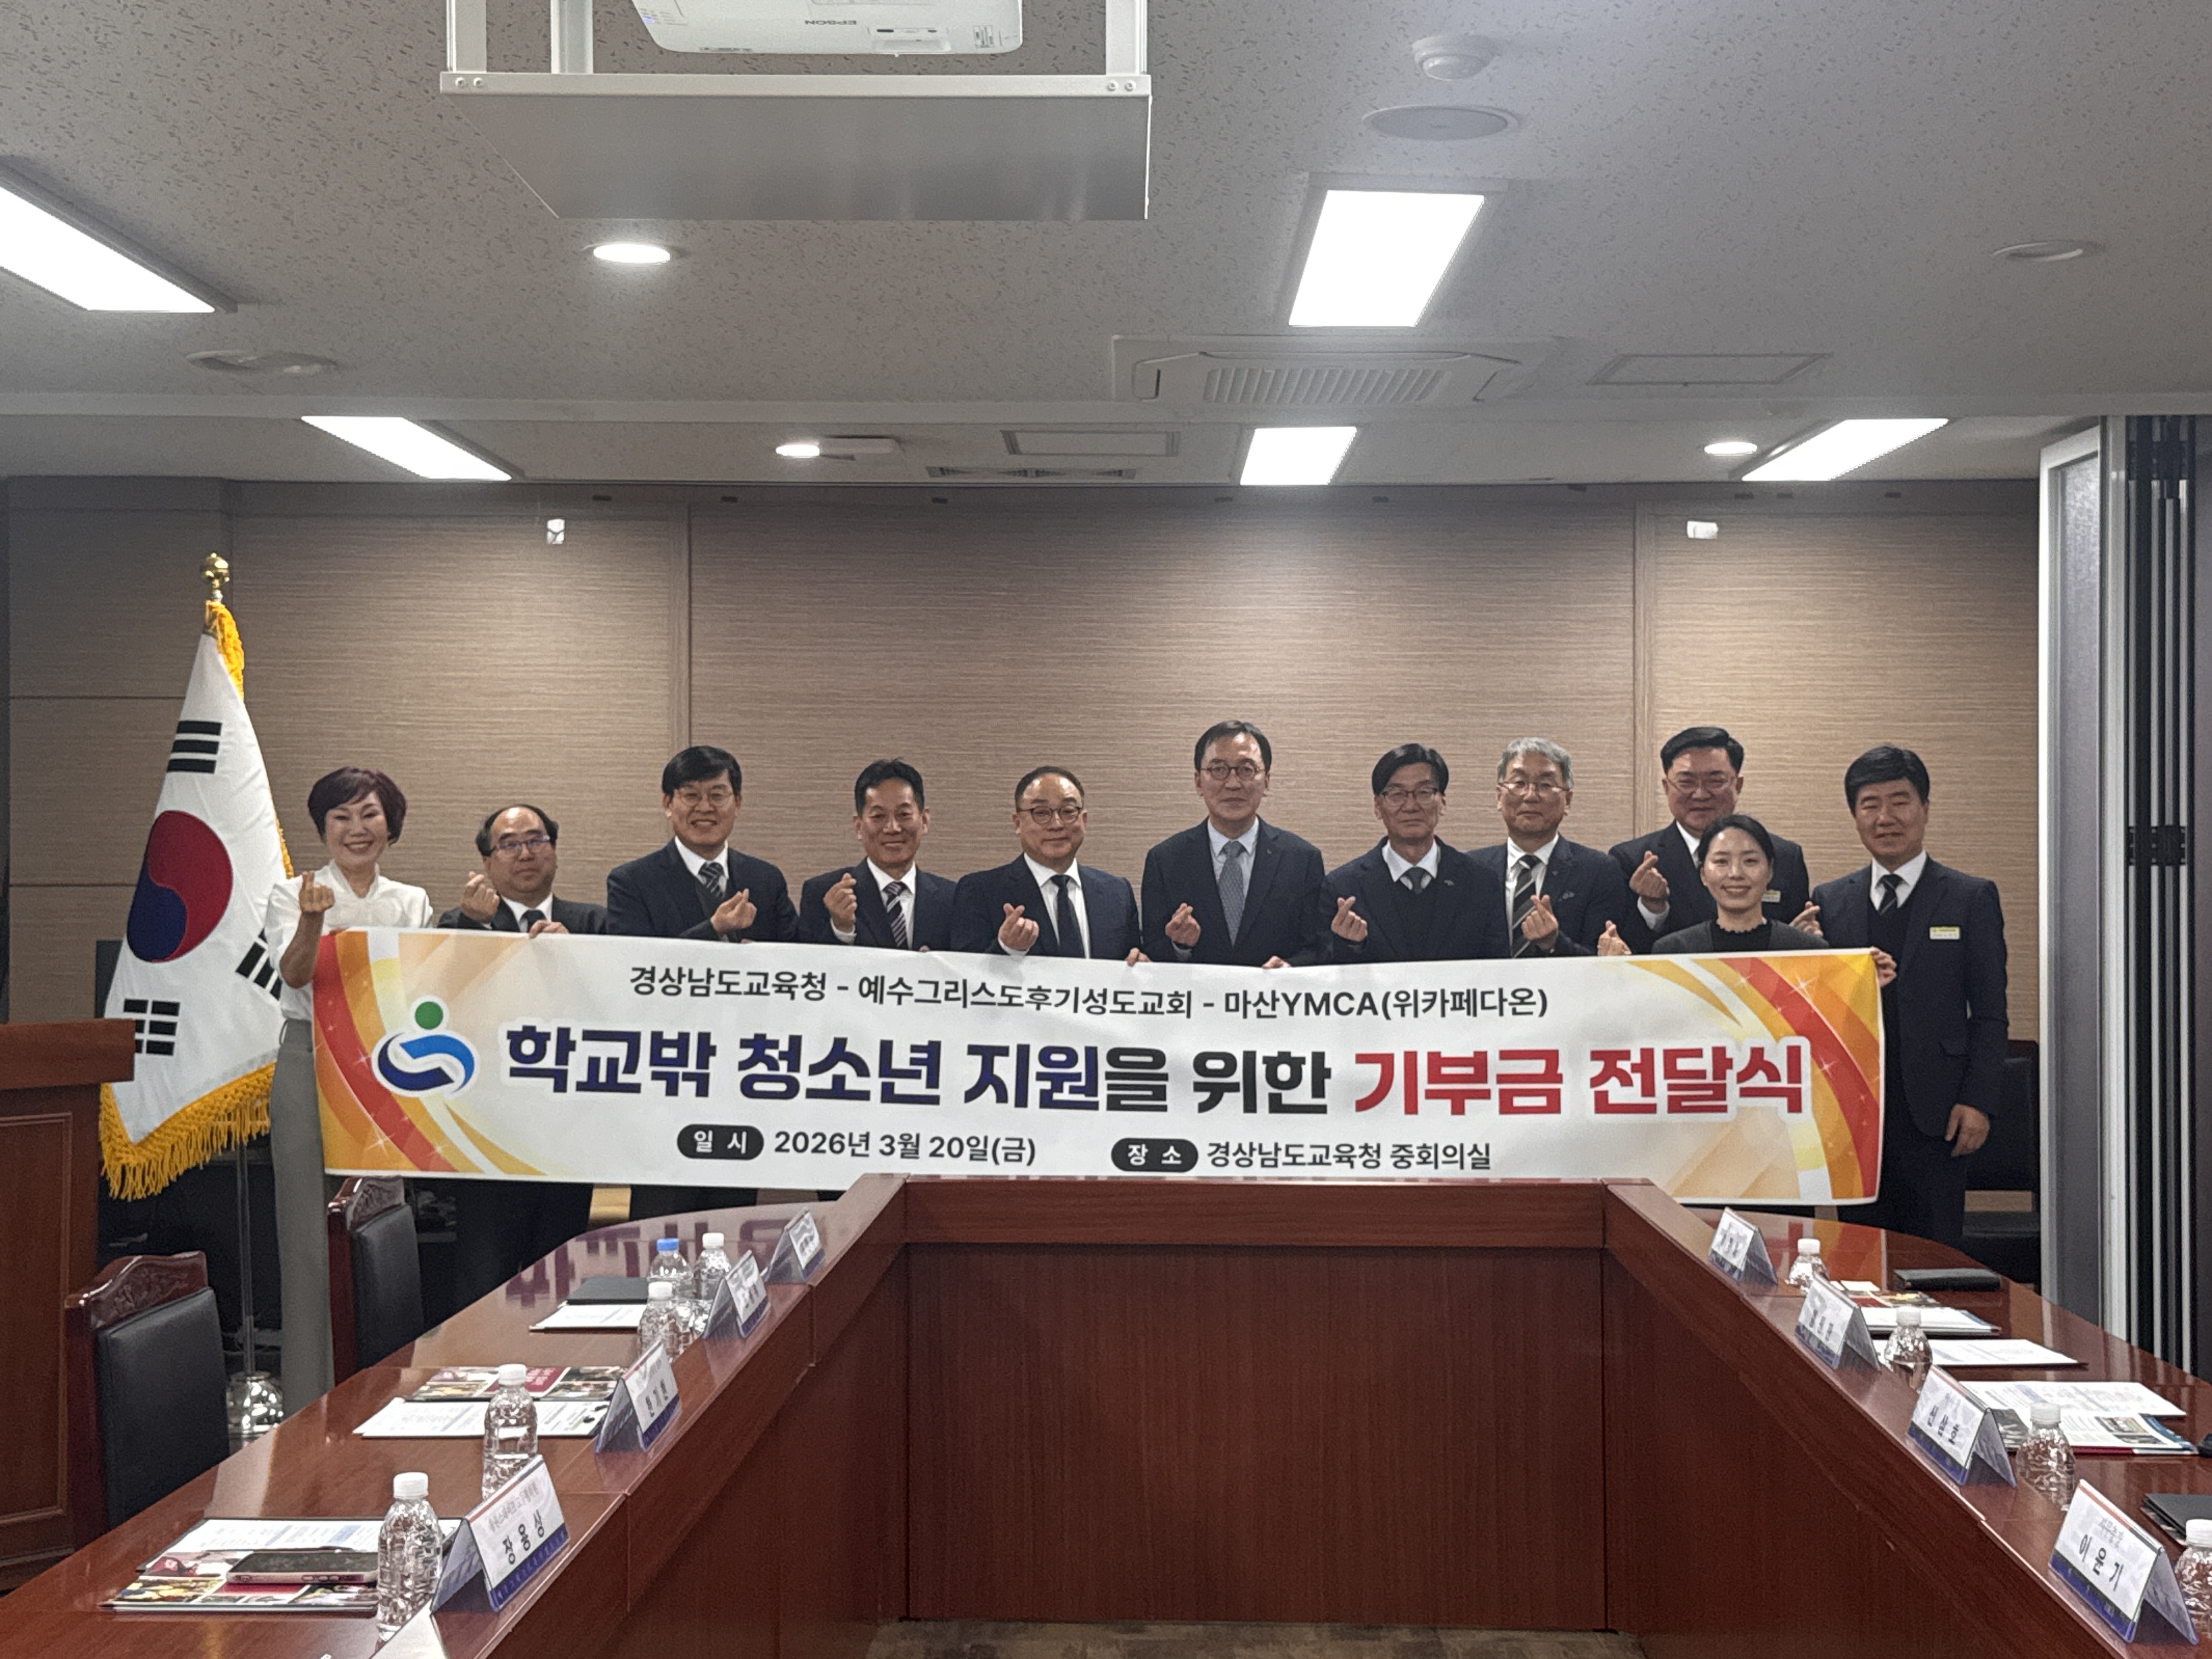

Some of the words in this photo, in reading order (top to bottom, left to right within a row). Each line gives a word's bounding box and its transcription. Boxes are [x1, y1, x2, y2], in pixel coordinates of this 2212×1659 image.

[630, 966, 826, 1001] 경상남도교육청
[859, 975, 1192, 1019] 예수그리스도후기성도교회
[1225, 988, 1547, 1020] 마산YMCA(위카페다온)
[506, 1025, 716, 1098] 학교밖
[738, 1033, 941, 1105] 청소년
[964, 1044, 1169, 1112] 지원을
[1192, 1050, 1331, 1114] 위한
[1355, 1049, 1563, 1115] 기부금
[1590, 1045, 1803, 1114] 전달식
[775, 1131, 870, 1158] 2026년
[879, 1133, 920, 1159] 3월
[929, 1135, 1035, 1166] 20일(금)
[1207, 1142, 1381, 1169] 경상남도교육청
[1390, 1143, 1491, 1170] 중회의실
